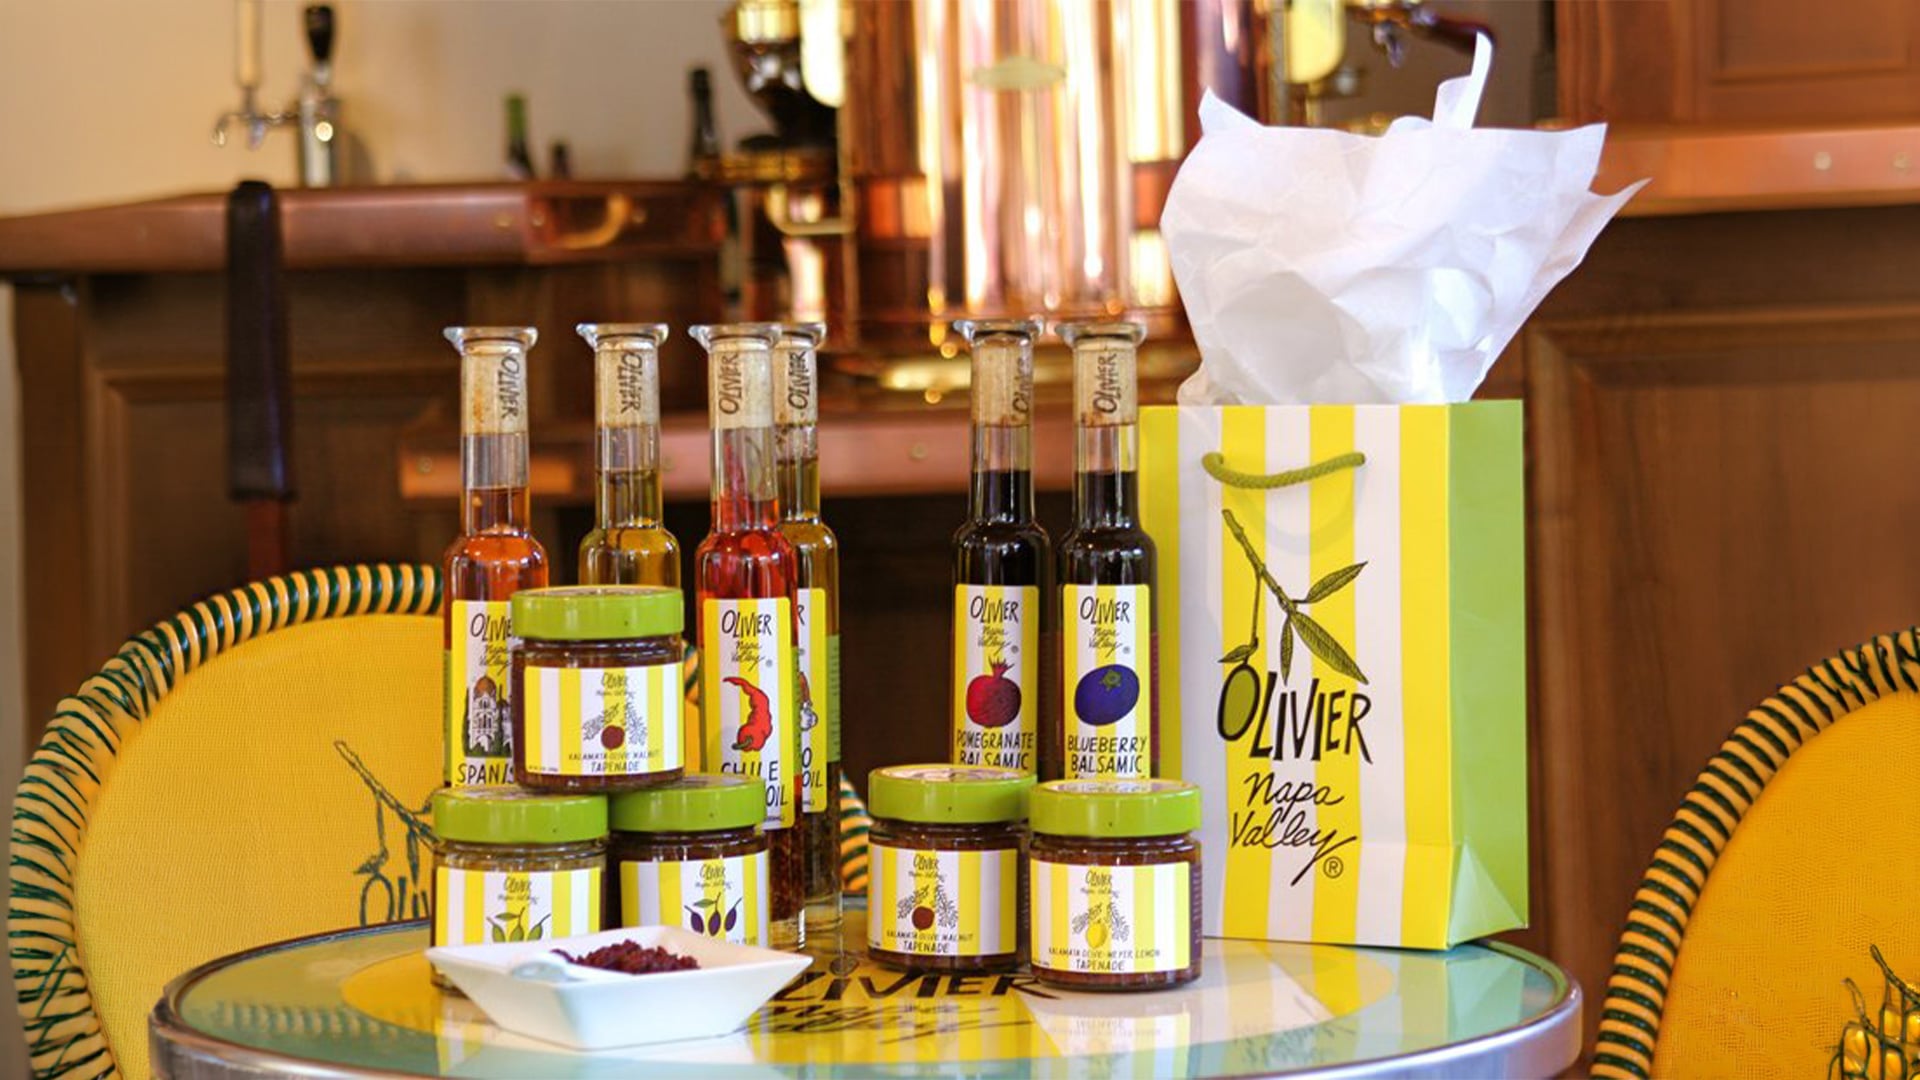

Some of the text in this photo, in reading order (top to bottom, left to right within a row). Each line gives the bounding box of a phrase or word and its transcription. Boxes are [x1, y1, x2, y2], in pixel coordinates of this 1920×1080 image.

[498, 353, 521, 420] OLIVIER
[617, 351, 643, 414] OLIVIER
[718, 351, 743, 415] OLIVIER
[788, 350, 810, 410] OLIVIER
[1093, 352, 1122, 414] OLIVIER
[721, 610, 772, 638] OLIVIER
[970, 596, 1018, 624] OLIVIER
[1080, 596, 1130, 624] OLIVIER
[471, 613, 513, 641] OLIVIE
[1217, 663, 1373, 764] OLIVIER
[956, 730, 1034, 750] POMEGRANATE
[1067, 735, 1148, 752] BLUEBERRY
[457, 763, 514, 784] SPANI
[591, 761, 640, 773] TAPENADE
[960, 752, 1030, 770] BALSAMIC
[1071, 754, 1143, 773] BALSAMIC
[802, 769, 823, 788] OIL
[766, 784, 788, 806] OIL
[1244, 772, 1345, 823] Napa
[1231, 806, 1357, 886] Valley
[903, 940, 950, 953] TAPENADE
[1076, 959, 1125, 971] TAPENADE
[768, 970, 1062, 1001] LIVIER
